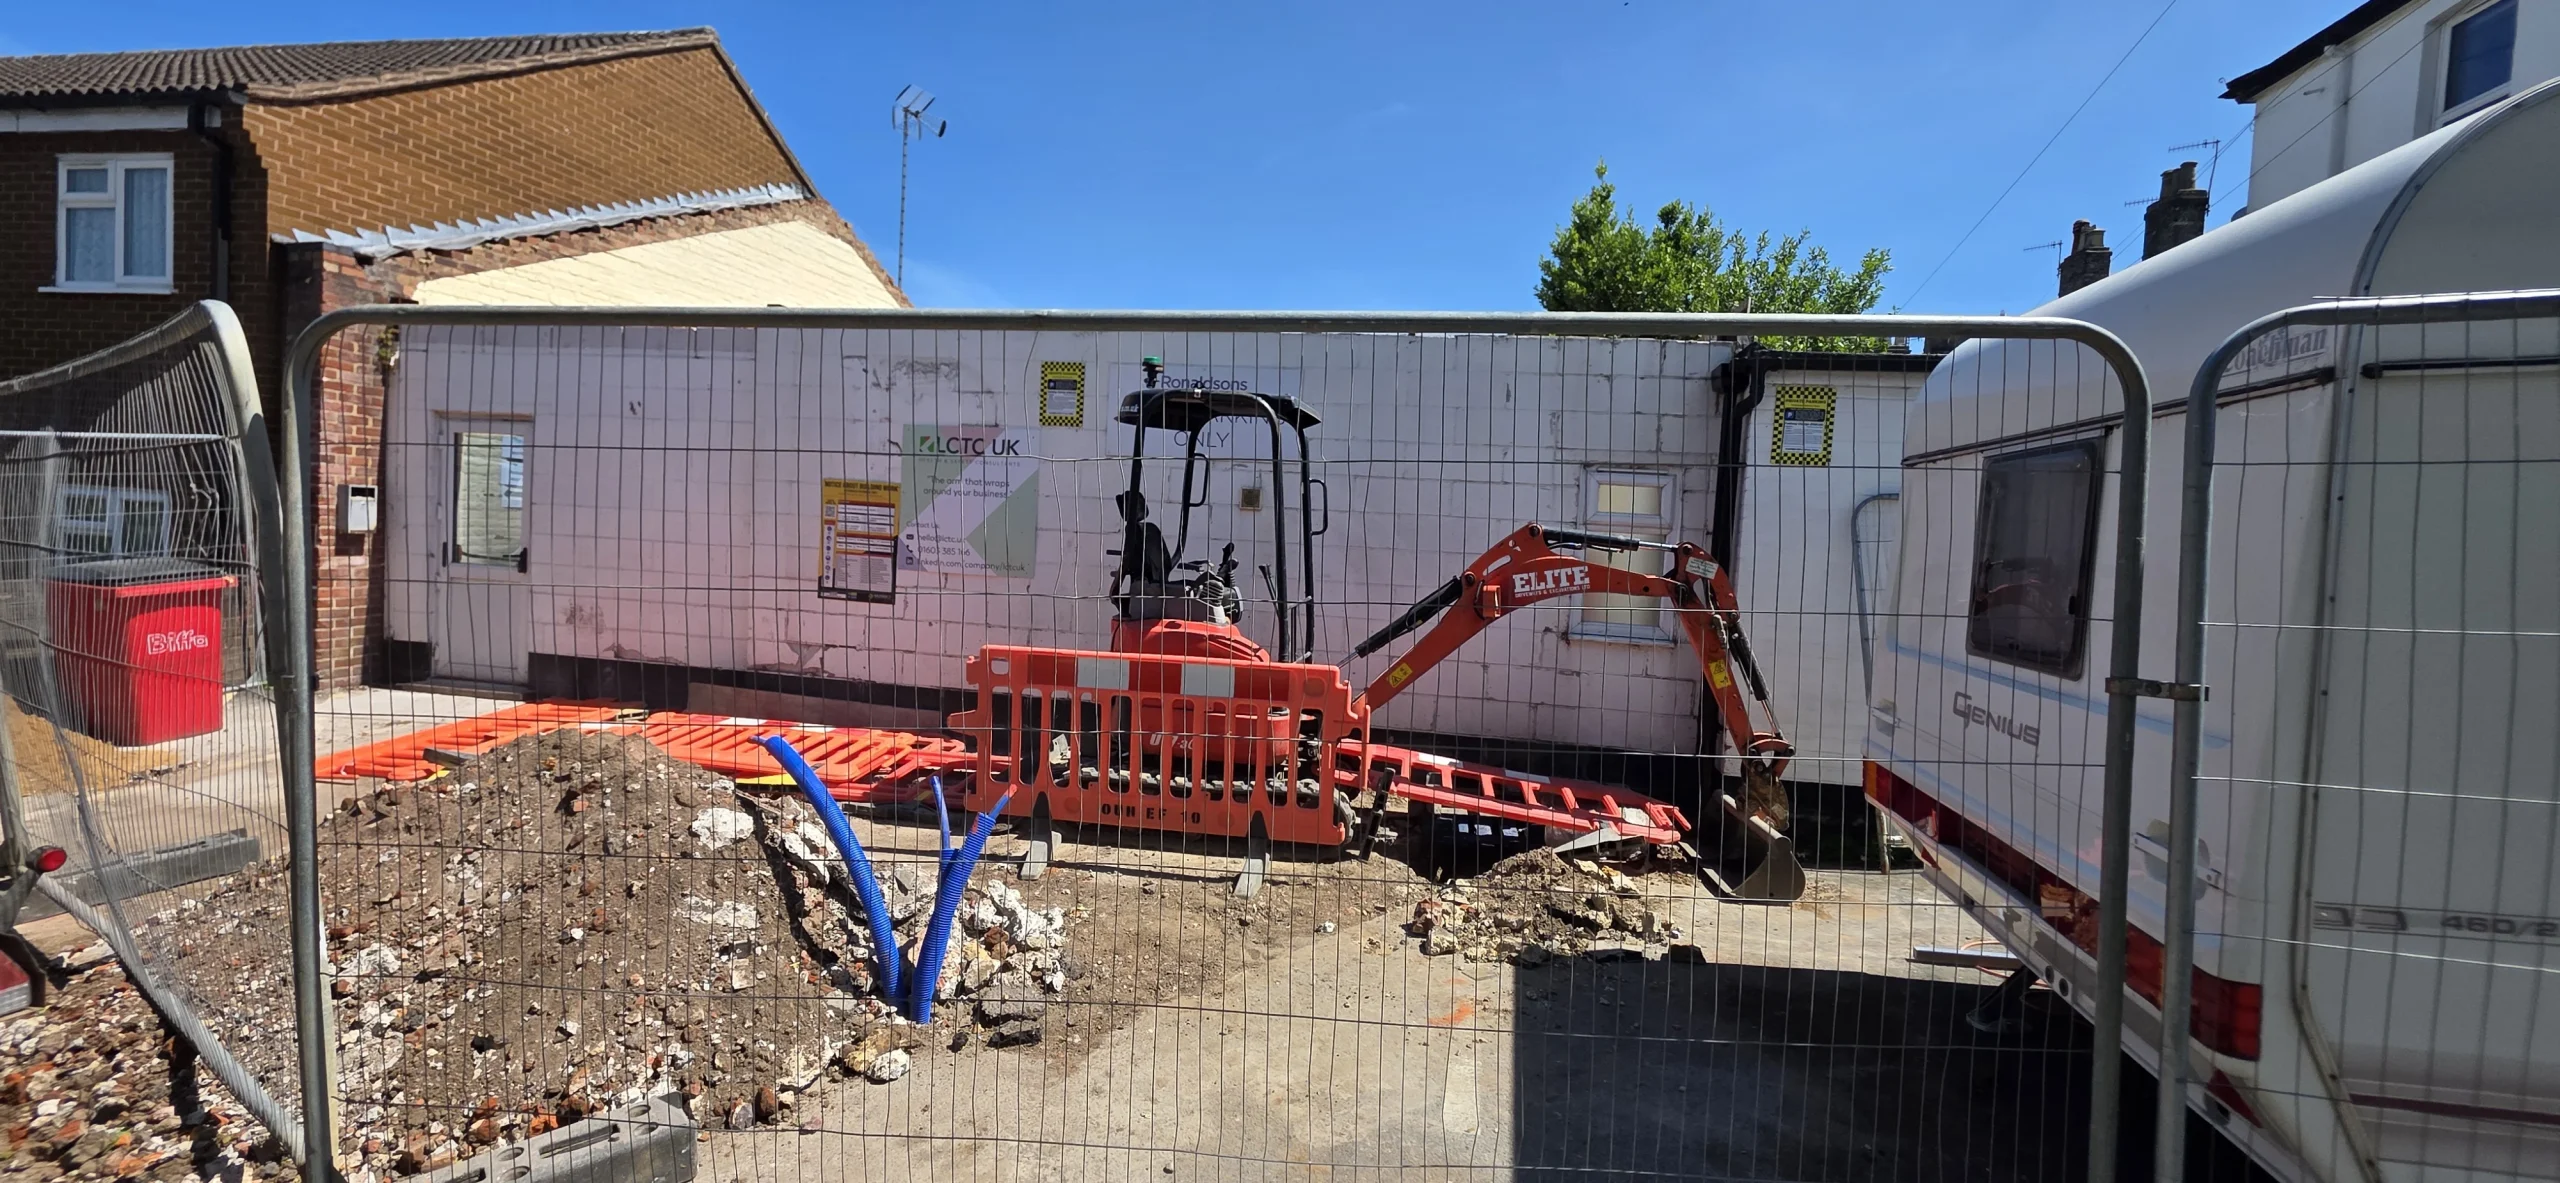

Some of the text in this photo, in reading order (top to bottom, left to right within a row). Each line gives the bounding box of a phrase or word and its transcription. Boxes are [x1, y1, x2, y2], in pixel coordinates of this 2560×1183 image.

[1160, 375, 1248, 391] Ronaldsons
[937, 436, 1020, 456] LCTC UK
[1173, 431, 1230, 448] ONLY
[965, 478, 983, 487] that
[984, 480, 1010, 489] wraps
[923, 487, 951, 496] around
[953, 489, 971, 497] your
[941, 547, 956, 556] 385
[917, 557, 1026, 572] inkedn.com/company/lctcuk
[1512, 565, 1590, 593] ELITE
[146, 629, 209, 655] Biffa
